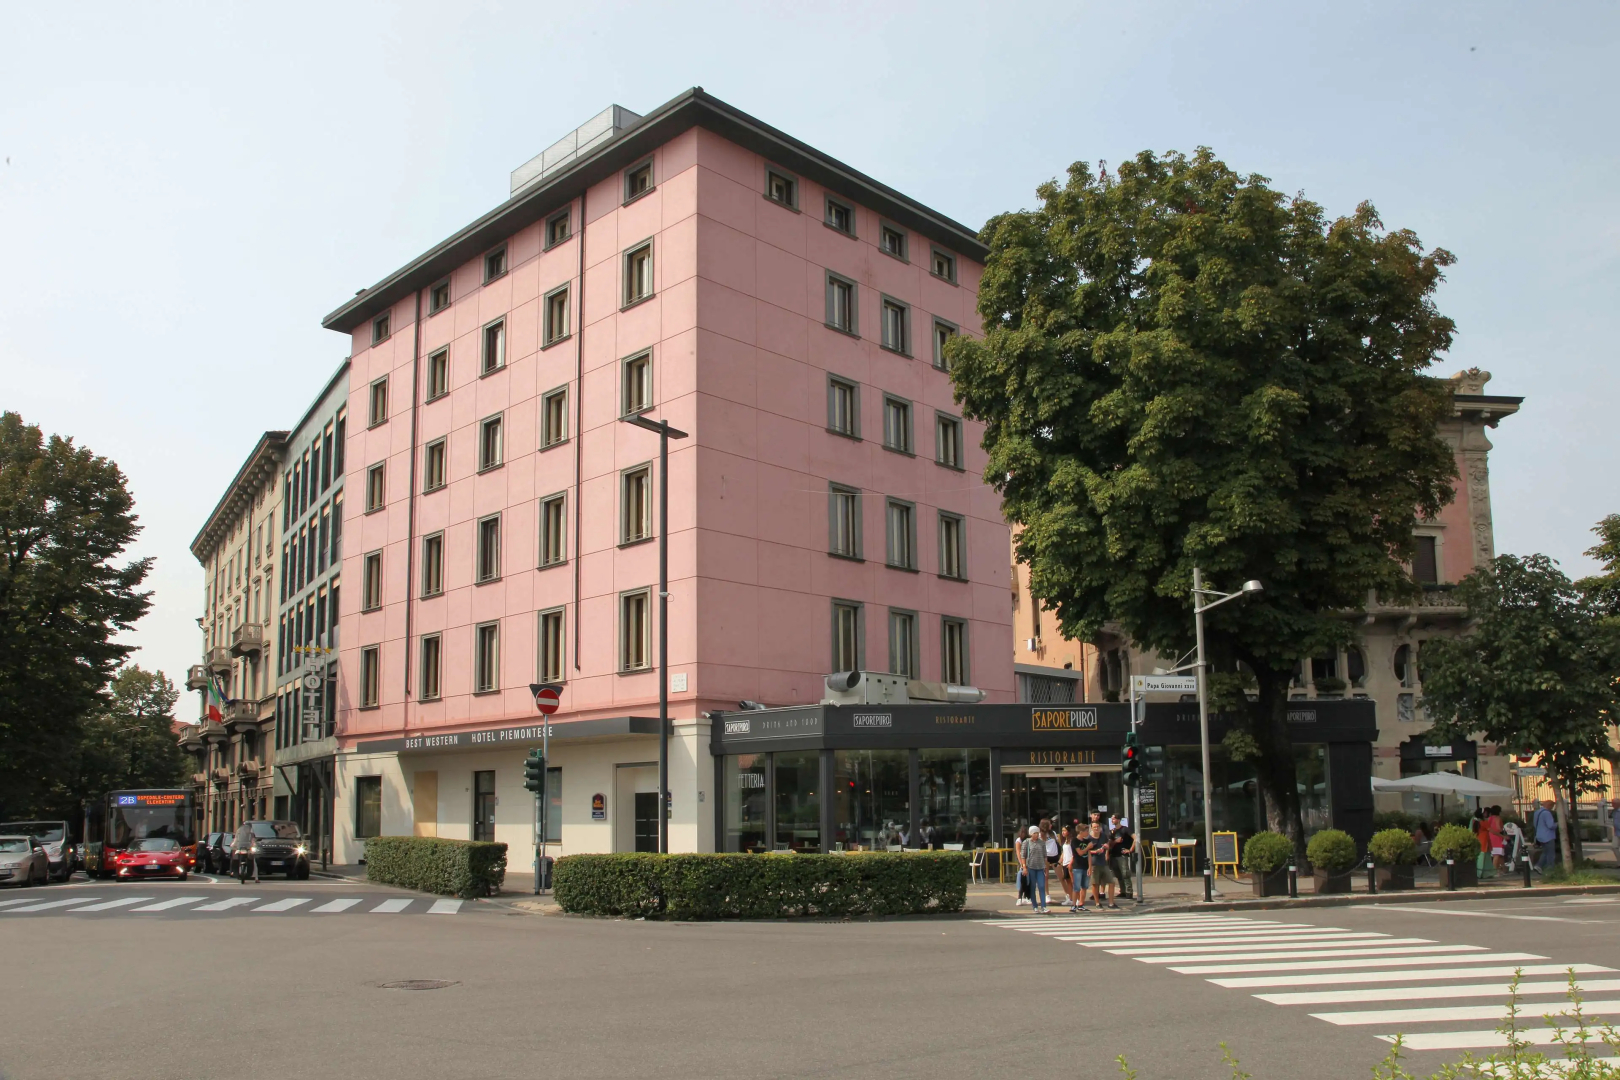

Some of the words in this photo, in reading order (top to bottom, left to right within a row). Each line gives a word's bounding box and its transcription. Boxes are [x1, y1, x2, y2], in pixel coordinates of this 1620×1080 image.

[855, 715, 891, 726] SAPOREPURO
[935, 716, 975, 724] RISTORANTE
[1035, 711, 1094, 728] SAPOREPURO
[471, 732, 496, 743] HOTEL
[500, 726, 553, 741] PIEMONTESE
[405, 738, 423, 749] BEST
[425, 735, 458, 747] WESTERN
[1030, 750, 1096, 764] RISTORANTE
[120, 796, 135, 804] 2B
